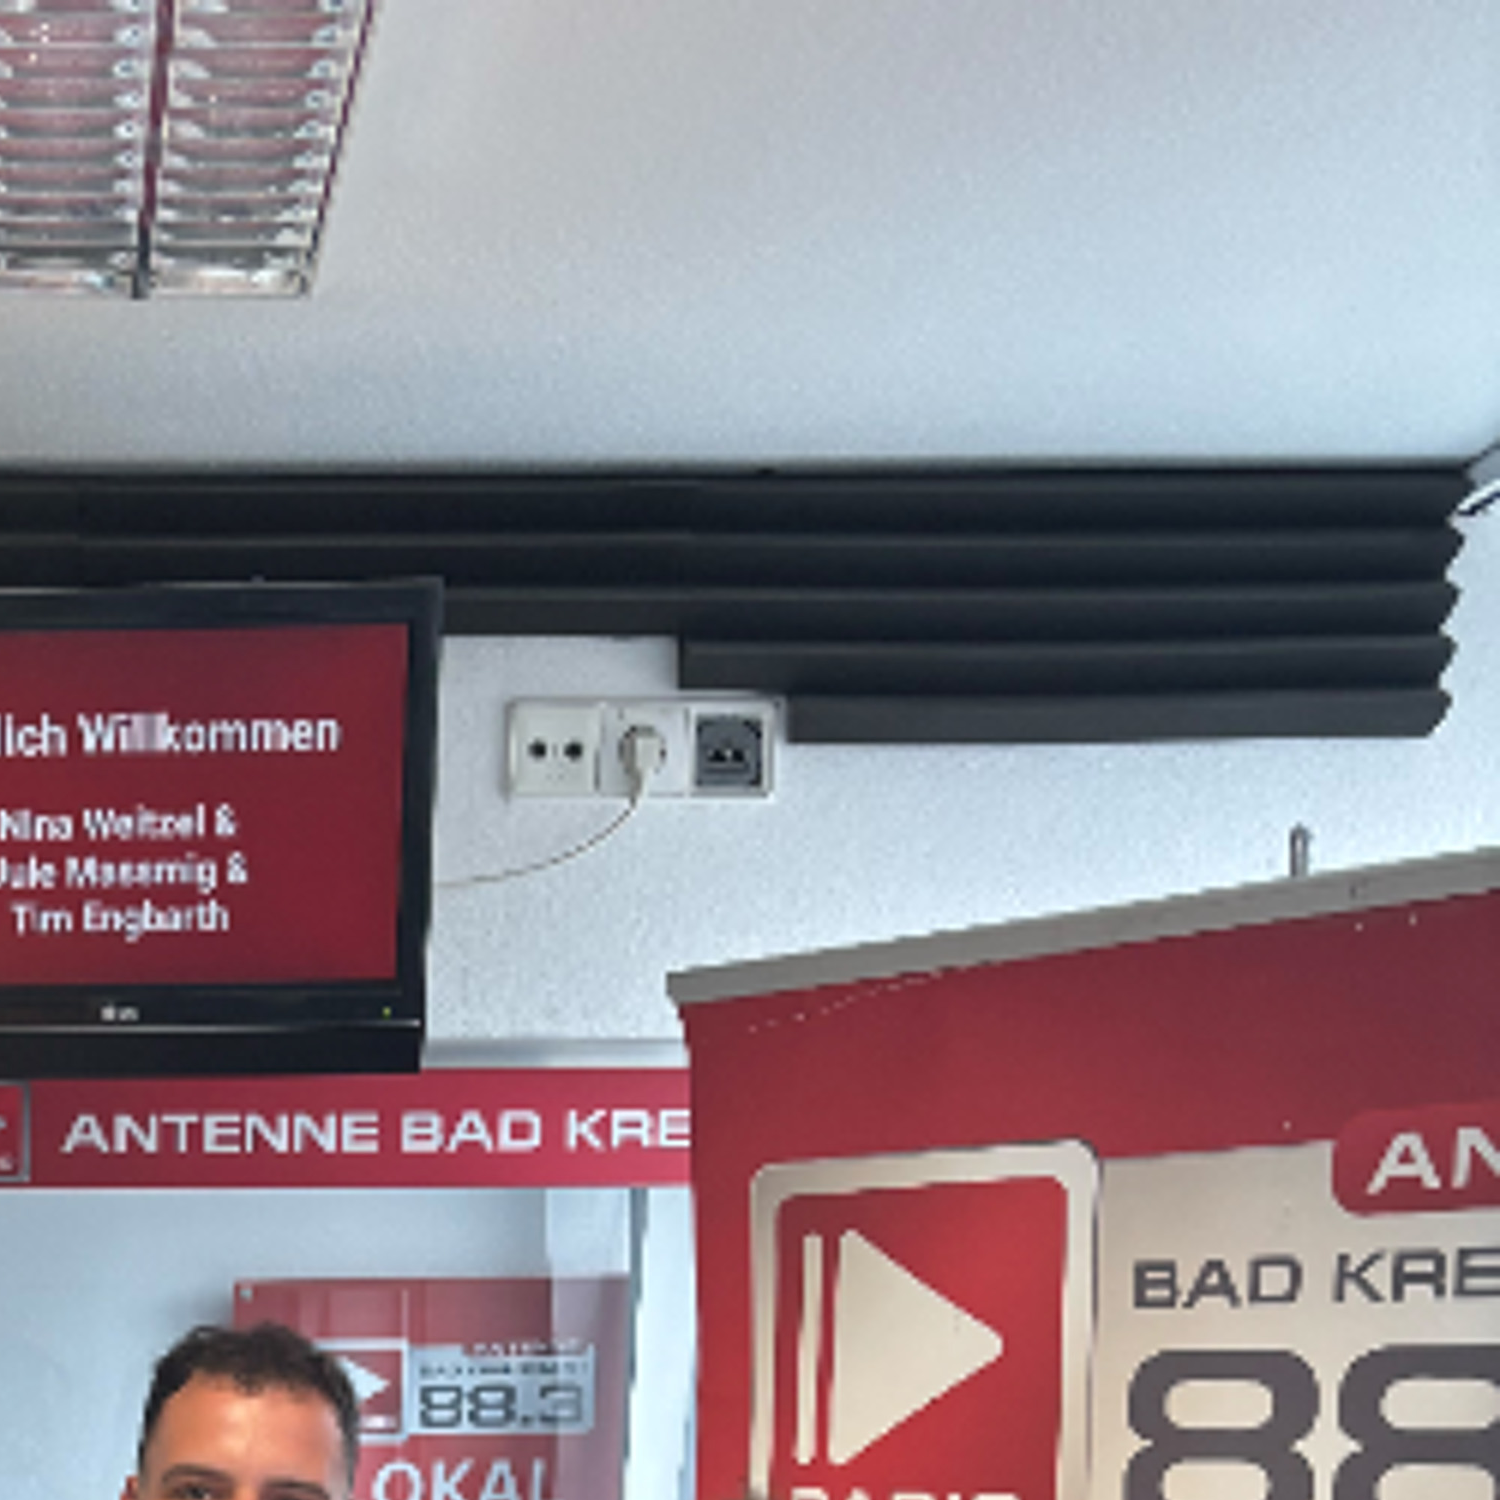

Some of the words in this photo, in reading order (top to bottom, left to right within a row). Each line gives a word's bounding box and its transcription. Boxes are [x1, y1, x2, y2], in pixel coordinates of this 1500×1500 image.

[77, 712, 342, 754] Willkommen
[0, 809, 73, 841] Nina
[214, 803, 239, 837] &
[226, 851, 248, 884] &
[11, 900, 73, 936] Tim
[60, 1111, 379, 1154] ANTENNE
[401, 1109, 542, 1153] BAD
[566, 1108, 691, 1150] KRE
[1366, 1127, 1500, 1195] AN
[1133, 1256, 1303, 1309] BAD
[1333, 1247, 1500, 1303] KRE
[420, 1384, 585, 1429] 88.3
